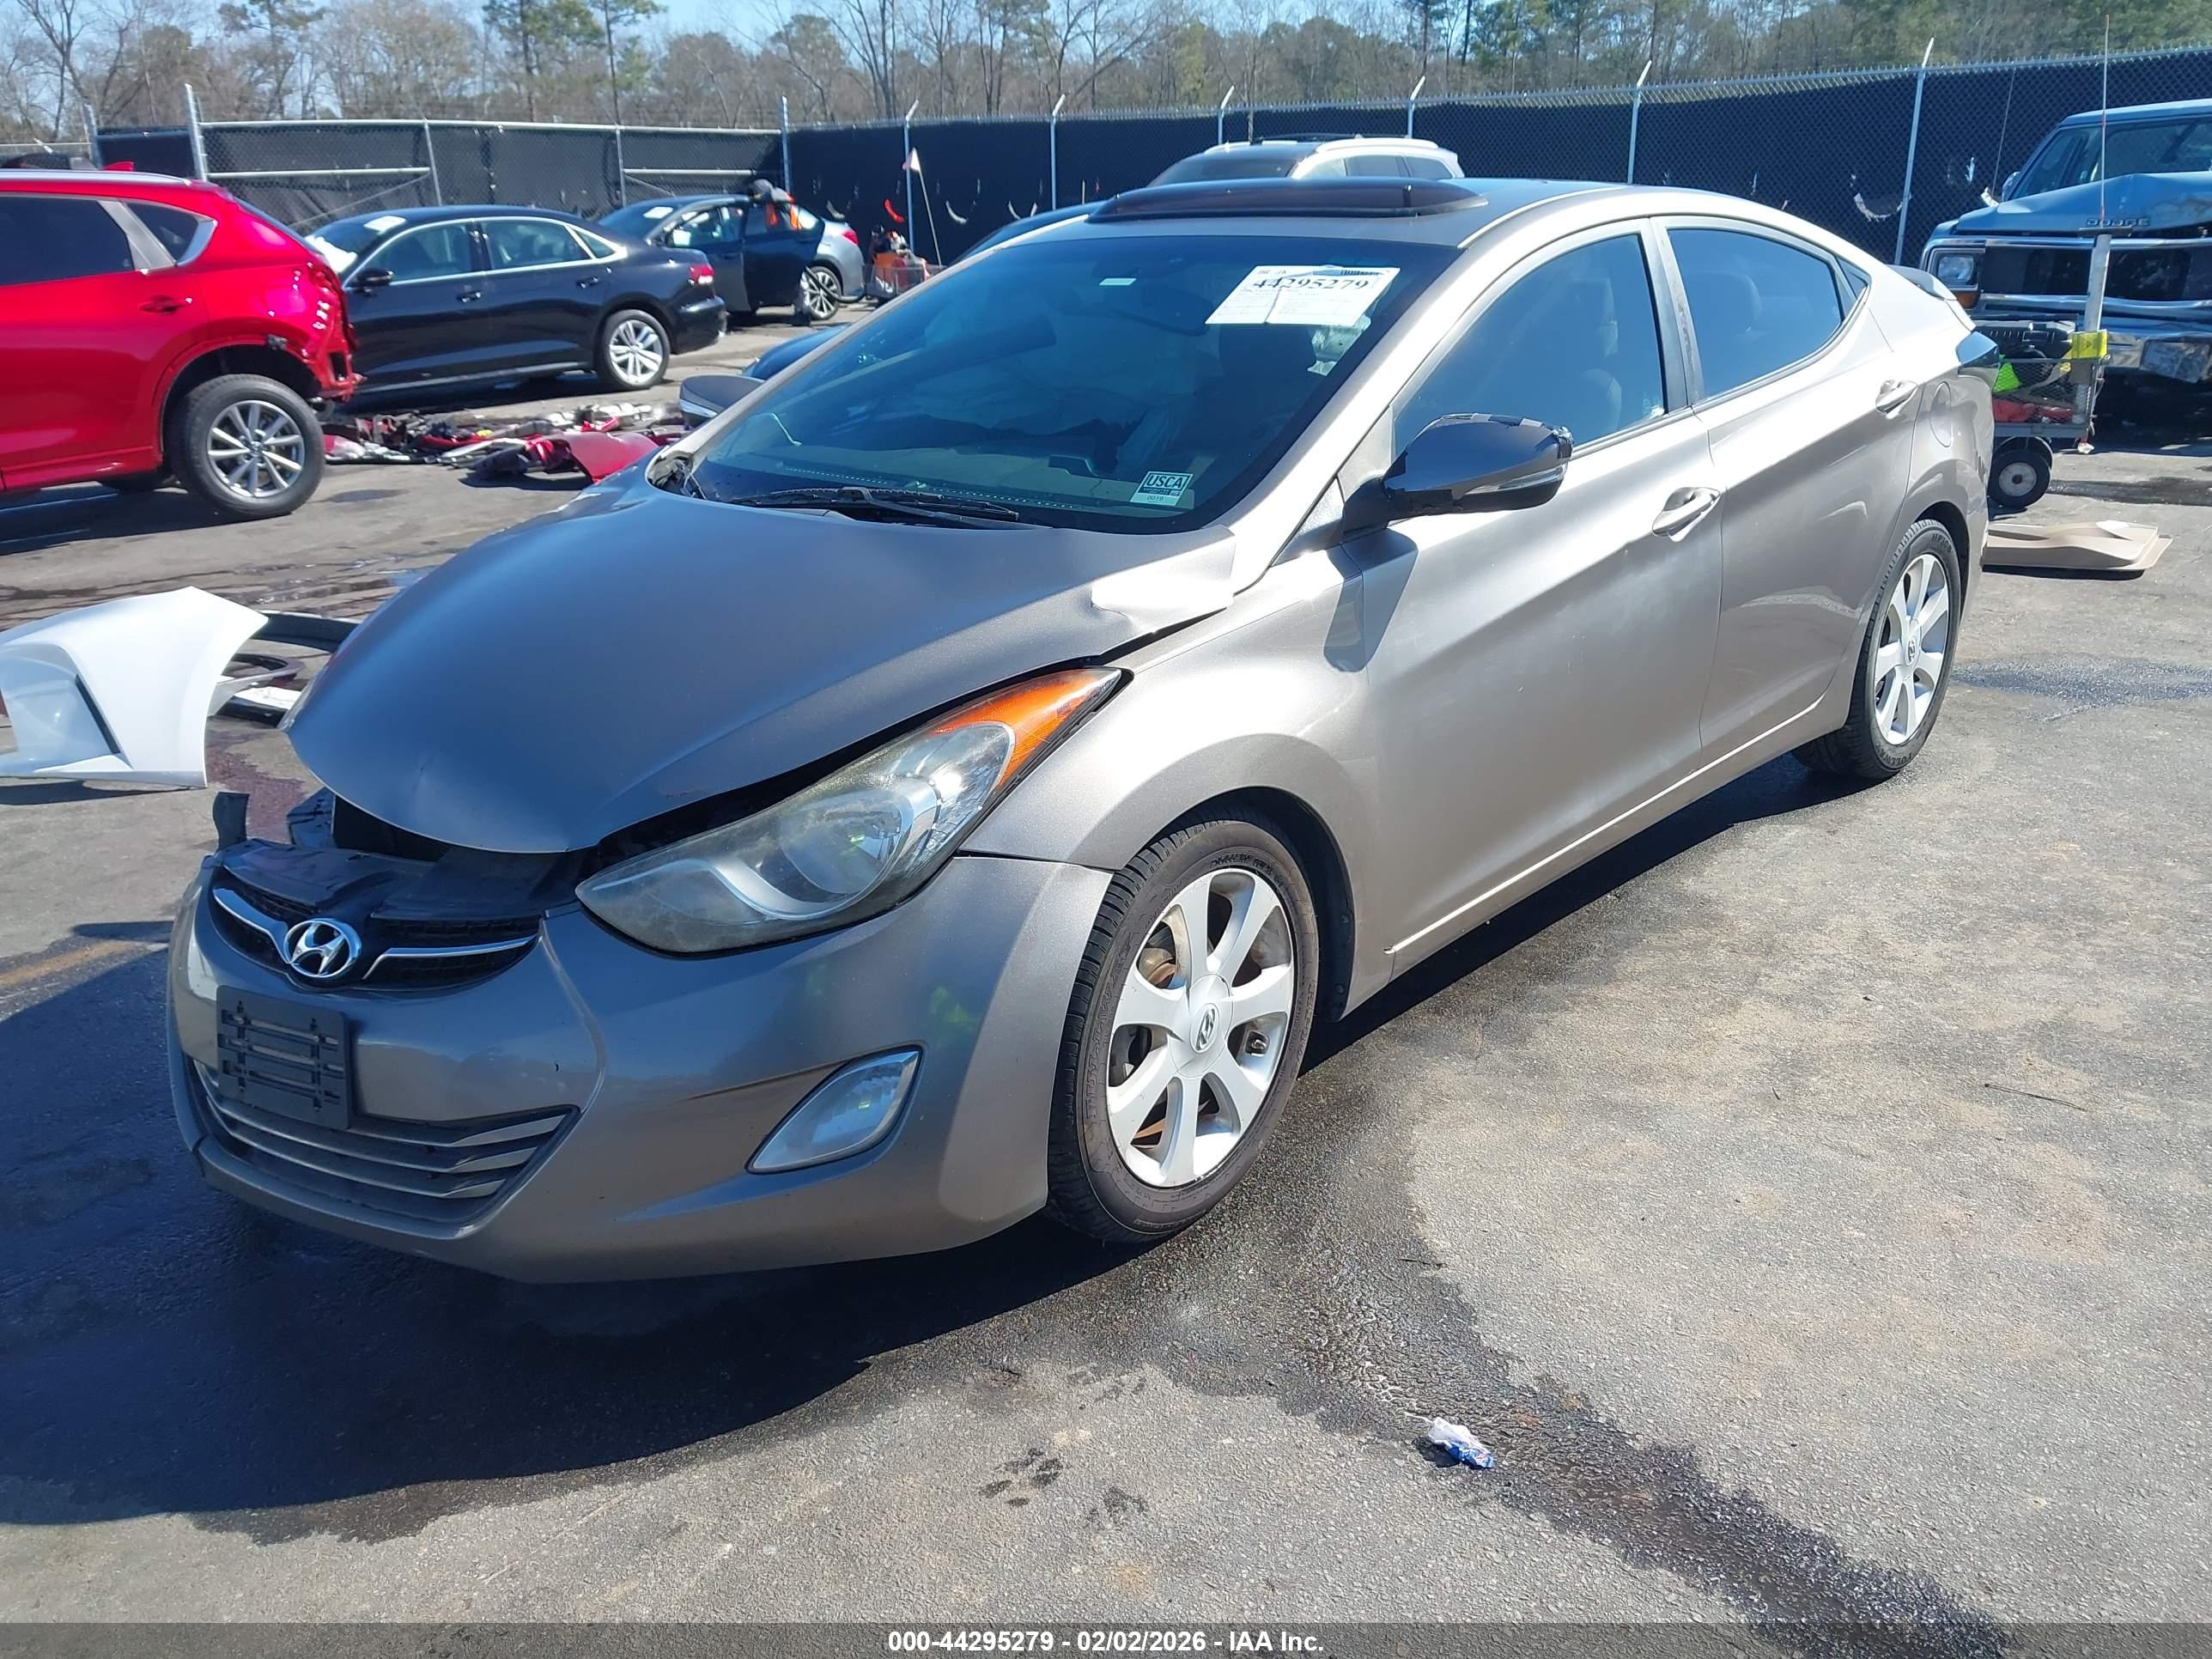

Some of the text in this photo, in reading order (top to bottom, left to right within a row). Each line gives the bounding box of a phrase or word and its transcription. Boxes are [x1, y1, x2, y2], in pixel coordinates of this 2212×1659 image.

[2087, 217, 2151, 228] DODGE
[1253, 276, 1370, 289] 44295279
[1146, 475, 1184, 489] USCA
